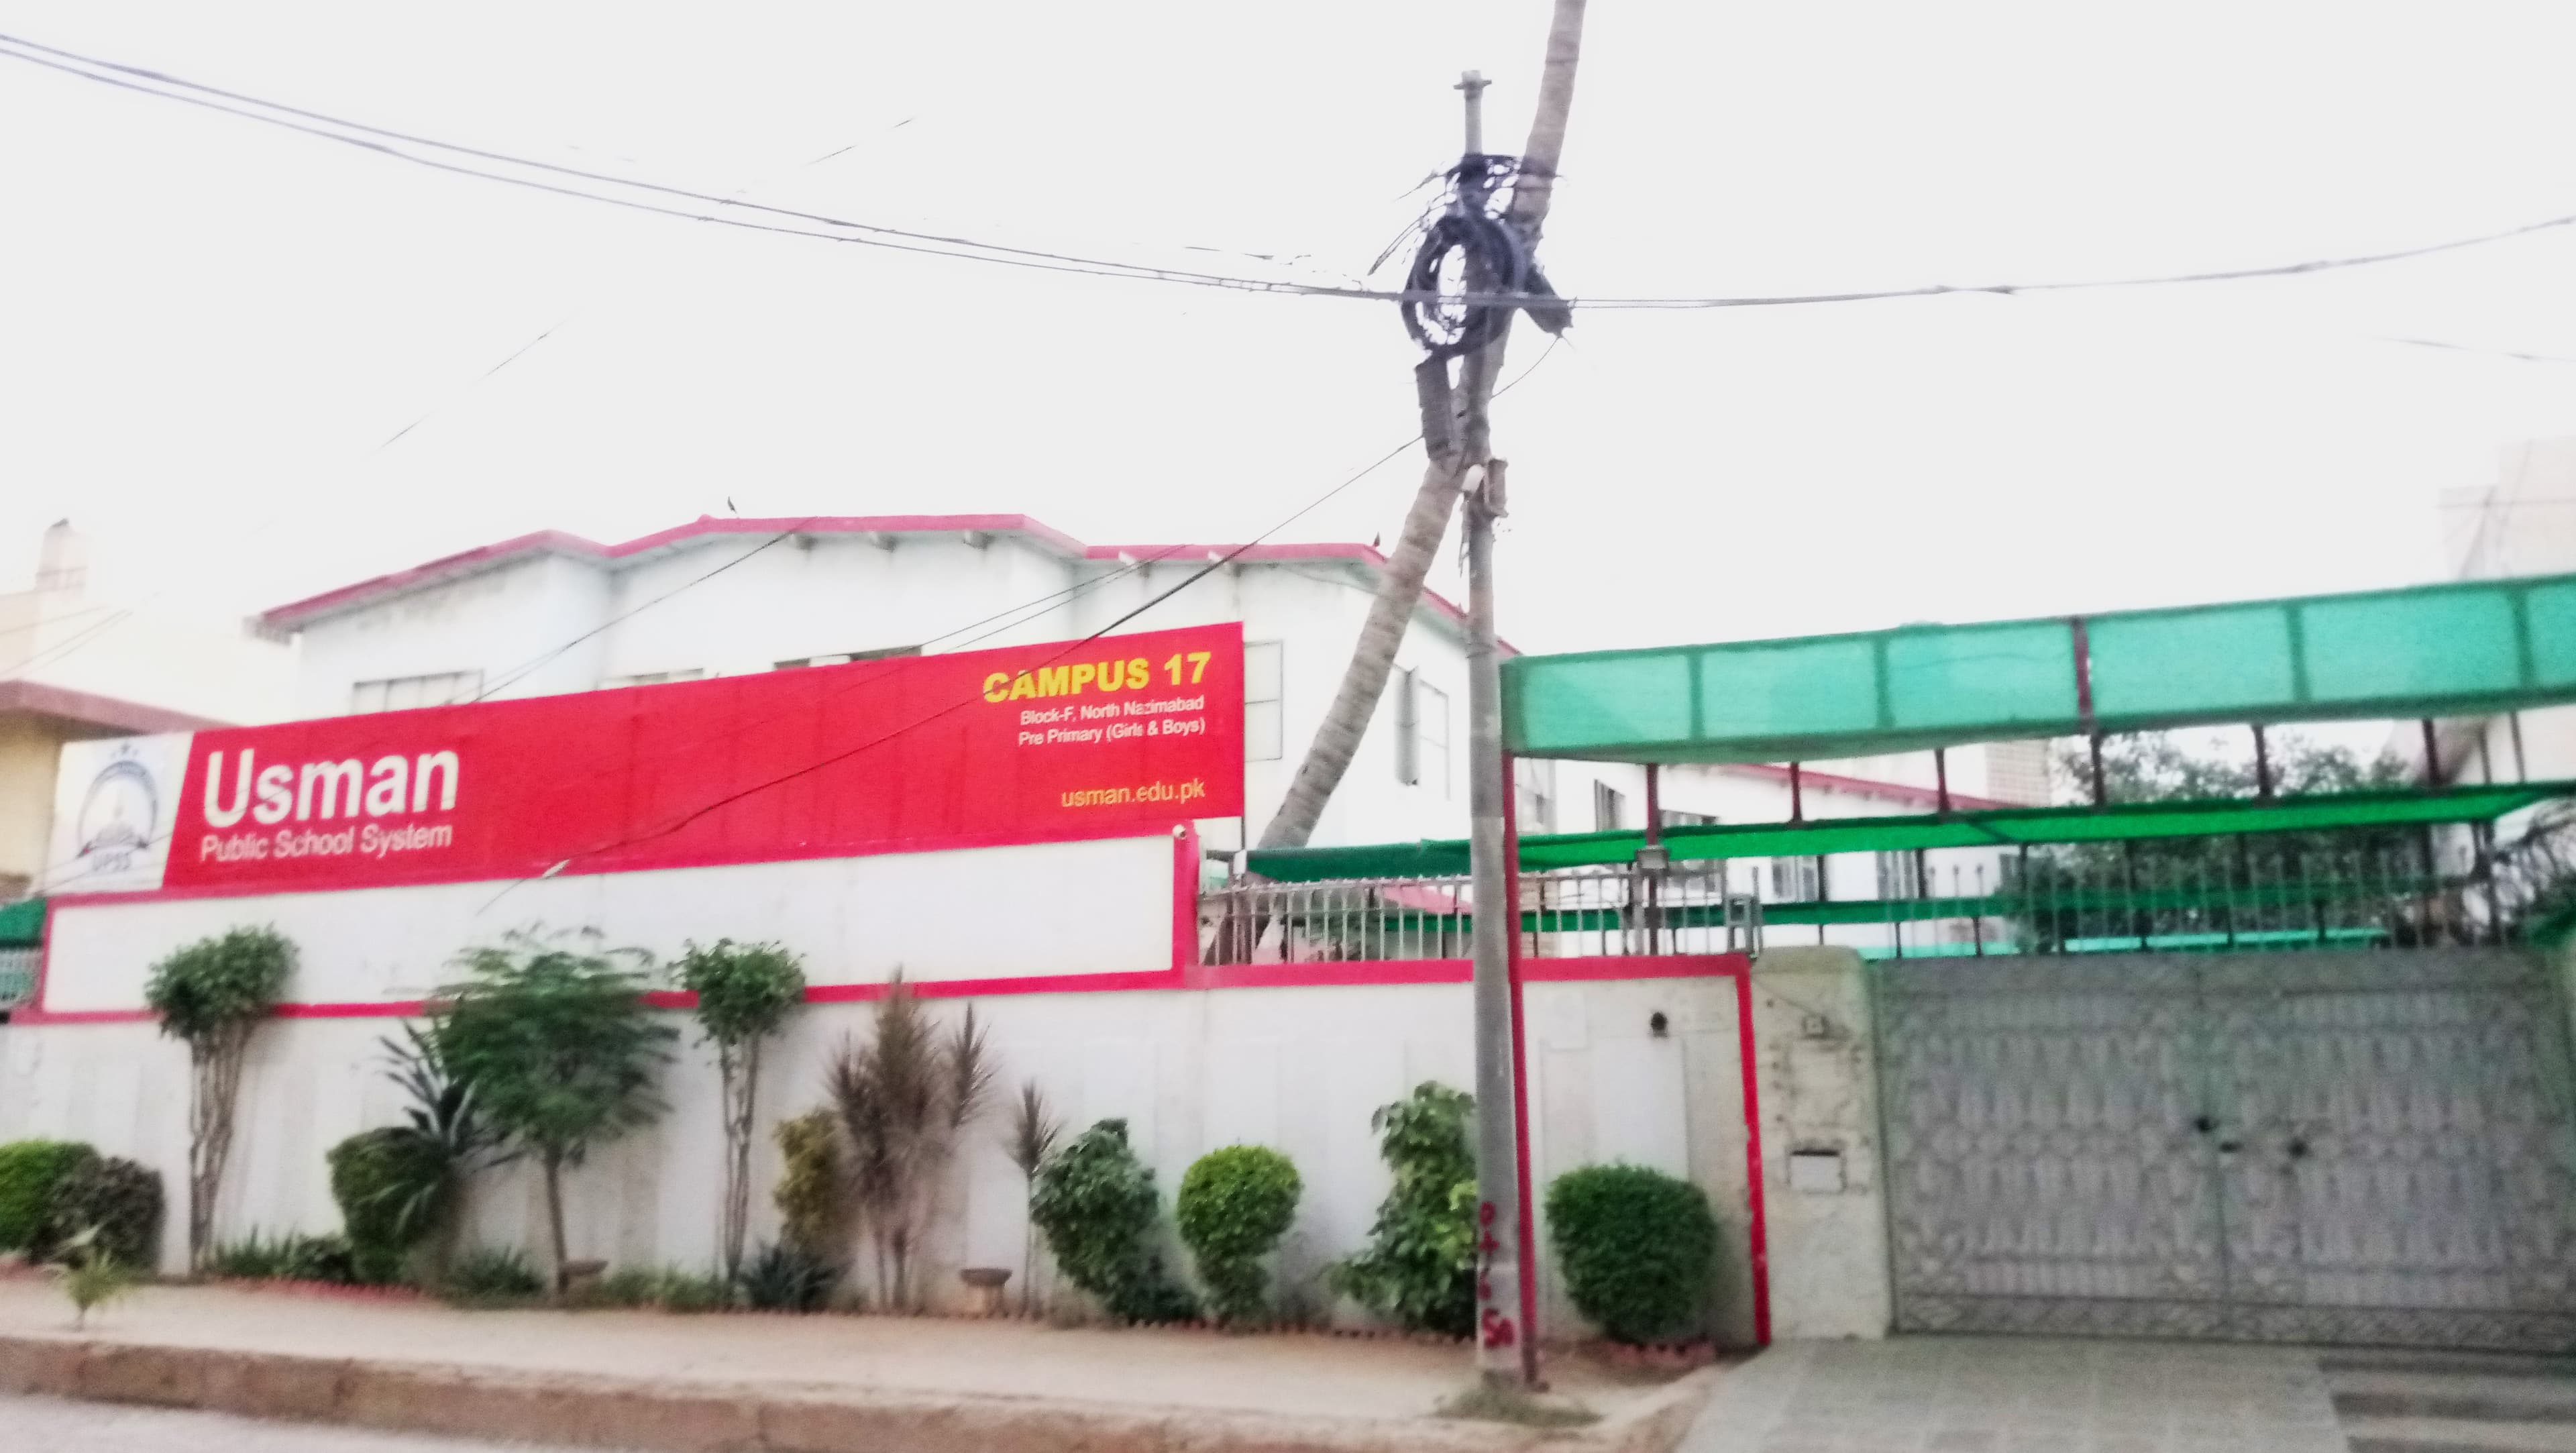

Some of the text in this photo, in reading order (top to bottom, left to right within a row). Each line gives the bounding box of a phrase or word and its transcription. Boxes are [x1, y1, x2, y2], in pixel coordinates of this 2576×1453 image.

[983, 651, 1212, 702] CAMPUS 17
[1081, 702, 1120, 720] North
[1123, 694, 1205, 716] Nazimabad
[1018, 717, 1206, 745] Pre Primary (Girls & Boys)
[203, 748, 459, 828] Usman
[1062, 778, 1206, 808] usman.edu.pk
[201, 824, 452, 862] Public School System
